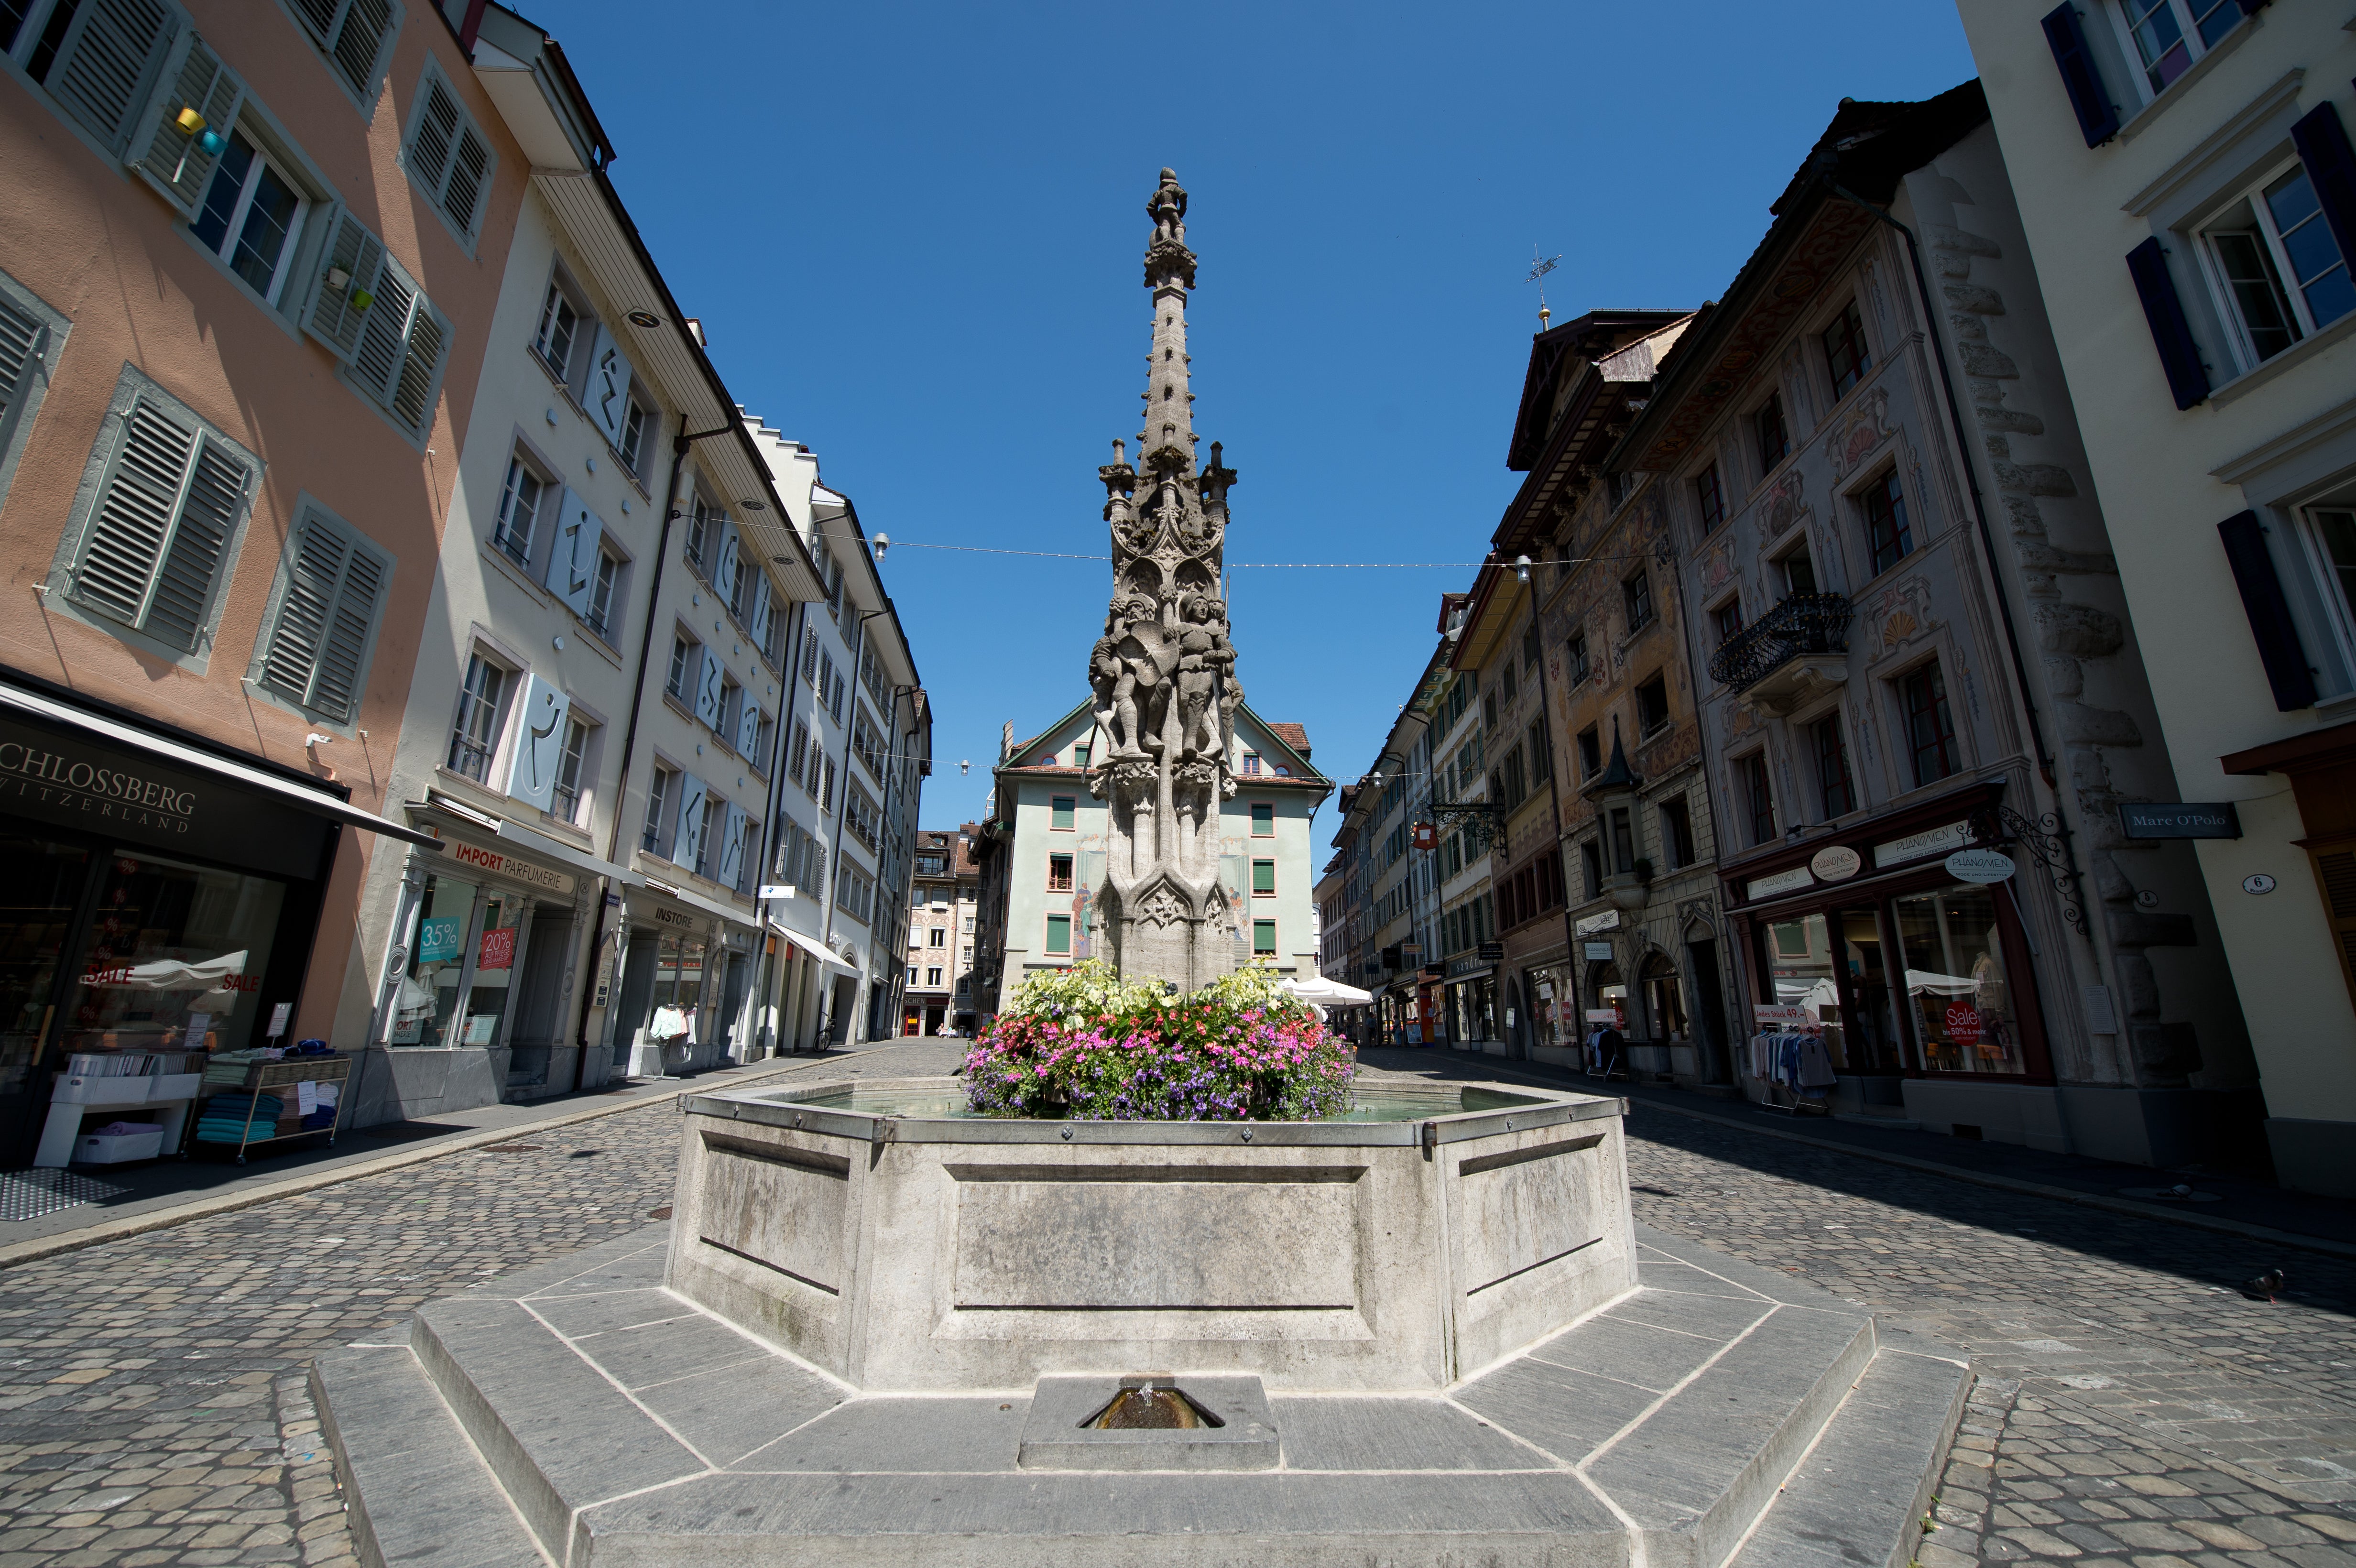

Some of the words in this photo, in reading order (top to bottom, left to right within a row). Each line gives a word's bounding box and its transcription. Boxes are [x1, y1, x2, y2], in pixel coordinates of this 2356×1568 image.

[2132, 816, 2173, 826] Marc
[2177, 815, 2226, 826] O'Polo
[1896, 827, 1949, 852] PHÄNOMEN
[456, 844, 503, 871] IMPORT
[504, 859, 561, 889] PARFUMERIE
[1814, 850, 1855, 870] PHÄNOMEN
[1952, 857, 2008, 868] PHÄNOMEN
[1761, 871, 1797, 888] PHÄNOMEN
[2254, 877, 2262, 887] 6
[607, 895, 619, 905] einmarkt
[2145, 893, 2150, 901] 5
[655, 907, 693, 928] INSTORE
[423, 924, 456, 947] 35%
[485, 932, 511, 952] 20%
[494, 948, 510, 958] PFLEGE
[1457, 957, 1483, 972] sandro
[87, 965, 135, 984] SALE
[222, 974, 260, 992] SALE
[1947, 1008, 1978, 1025] Sale
[1951, 1027, 1966, 1035] 50%
